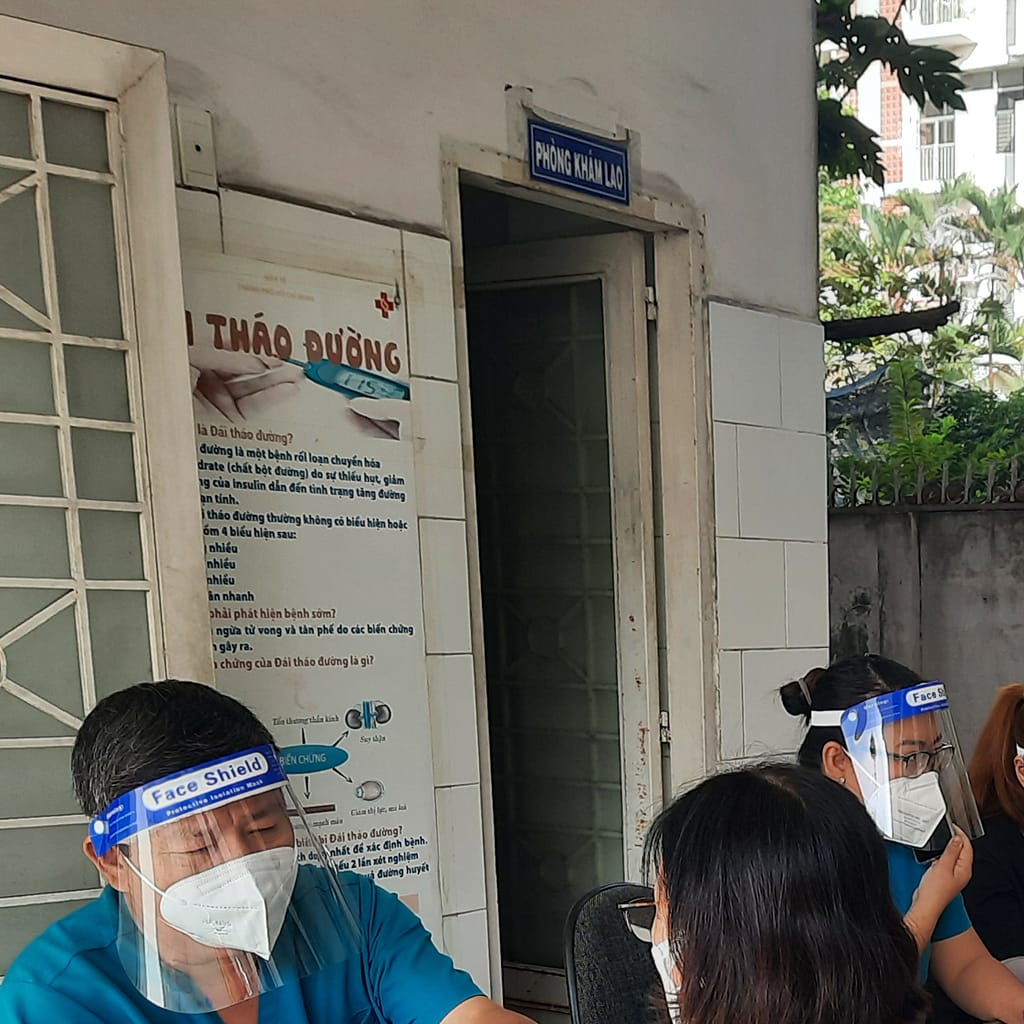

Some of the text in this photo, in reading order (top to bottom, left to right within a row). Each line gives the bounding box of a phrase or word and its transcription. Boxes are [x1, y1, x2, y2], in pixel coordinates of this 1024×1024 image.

[535, 138, 623, 191] PHÒNG KHÁM LAO
[206, 312, 292, 360] THÁO
[303, 326, 401, 375] ĐƯỜNG
[210, 425, 228, 438] Đái
[230, 427, 253, 440] tháo
[256, 429, 293, 446] đường?
[200, 443, 381, 468] đường là một bệnh rối loạn chuyển hóa
[227, 461, 253, 474] (chất
[255, 464, 272, 477] bột
[275, 466, 309, 480] đường)
[311, 469, 323, 479] do
[326, 471, 337, 482] sự
[338, 470, 362, 482] thiếu
[383, 474, 405, 487] giảm
[213, 476, 230, 489] của
[268, 480, 287, 492] dẫn
[289, 482, 307, 493] đến
[309, 484, 328, 495] tình
[330, 486, 354, 499] trạng
[356, 488, 376, 500] tăng
[378, 489, 406, 502] đường
[215, 493, 239, 505] tính.
[207, 510, 231, 521] tháo
[233, 511, 265, 525] đường
[267, 512, 301, 526] thường
[303, 514, 333, 528] không
[334, 516, 345, 526] có
[346, 516, 366, 527] biểu
[367, 518, 386, 531] hiện
[388, 519, 408, 532] hoặc
[222, 527, 228, 536] 4
[230, 525, 252, 537] biểu
[254, 528, 276, 541] hiện
[277, 530, 297, 539] sau:
[209, 542, 238, 553] nhiều
[207, 557, 236, 569] nhiều
[223, 591, 255, 601] nhanh
[234, 608, 258, 621] phát
[260, 608, 282, 621] hiện
[284, 608, 310, 621] bệnh
[312, 608, 336, 619] sớm?
[216, 623, 414, 638] ngừa tử vong và tàn phế do các biến chứng
[219, 641, 237, 653] gây
[240, 643, 253, 651] ra.
[220, 658, 252, 671] chứng
[255, 657, 272, 668] của
[274, 657, 291, 668] Đái
[294, 656, 315, 667] tháo
[318, 656, 349, 668] đường
[350, 655, 359, 665] là
[361, 655, 374, 667] gì?
[913, 691, 936, 703] Face
[151, 757, 262, 805] Face Shield
[166, 779, 264, 817] Protective Isolation Mask
[347, 830, 368, 841] tháo
[370, 825, 403, 838] đường?
[366, 841, 380, 852] xác
[383, 839, 402, 852] định
[405, 836, 428, 849] bệnh.
[351, 859, 358, 869] 2
[358, 856, 372, 868] lần
[388, 852, 419, 865] nghiệm
[377, 867, 404, 879] đường
[406, 862, 430, 875] huyết
